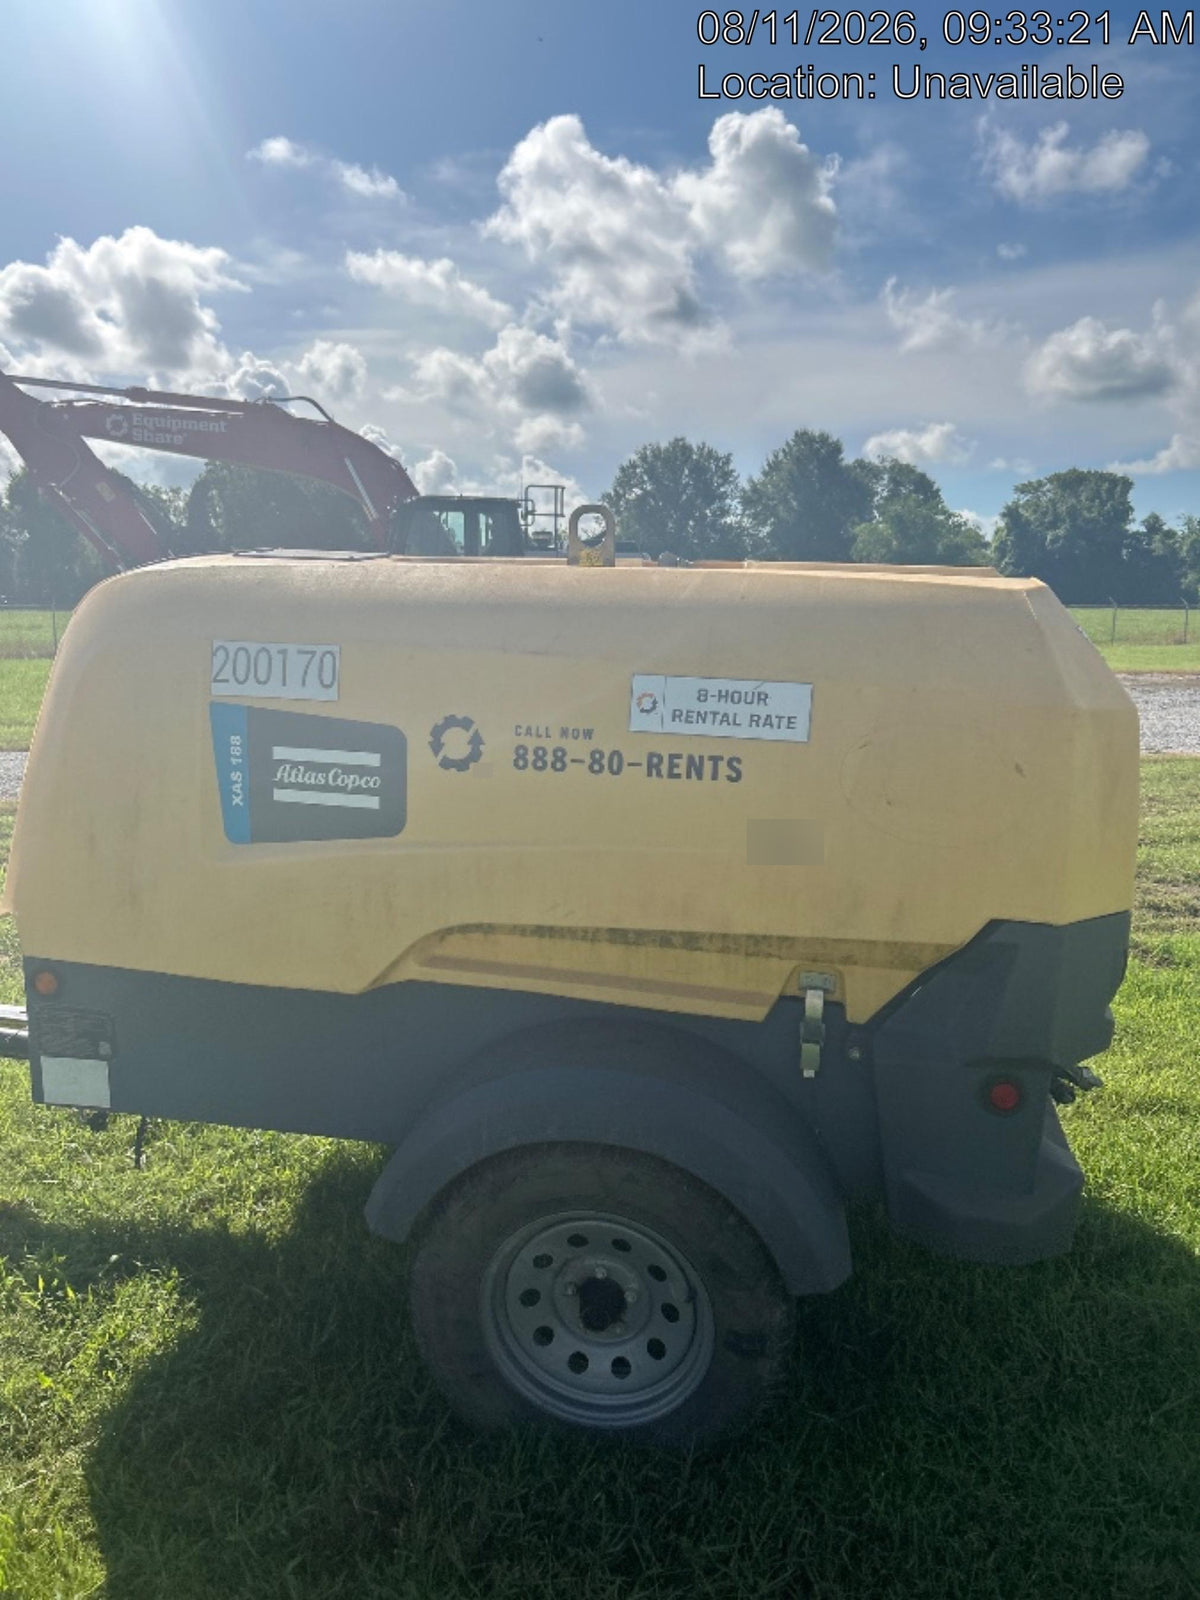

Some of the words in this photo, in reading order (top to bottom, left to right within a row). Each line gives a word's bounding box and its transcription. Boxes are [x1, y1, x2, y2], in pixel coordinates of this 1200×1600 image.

[131, 413, 228, 433] Equipment
[132, 427, 184, 446] Share
[212, 644, 336, 689] 200170
[696, 687, 769, 707] 8-HOUR
[671, 708, 742, 728] RENTAL
[749, 713, 798, 731] RATE
[514, 724, 552, 738] CALL
[559, 726, 594, 741] NOW
[230, 735, 242, 766] 188
[272, 763, 326, 786] Atlas
[328, 768, 381, 790] Copco
[513, 744, 743, 784] 888-80-RENTS
[230, 771, 244, 806] XAS
